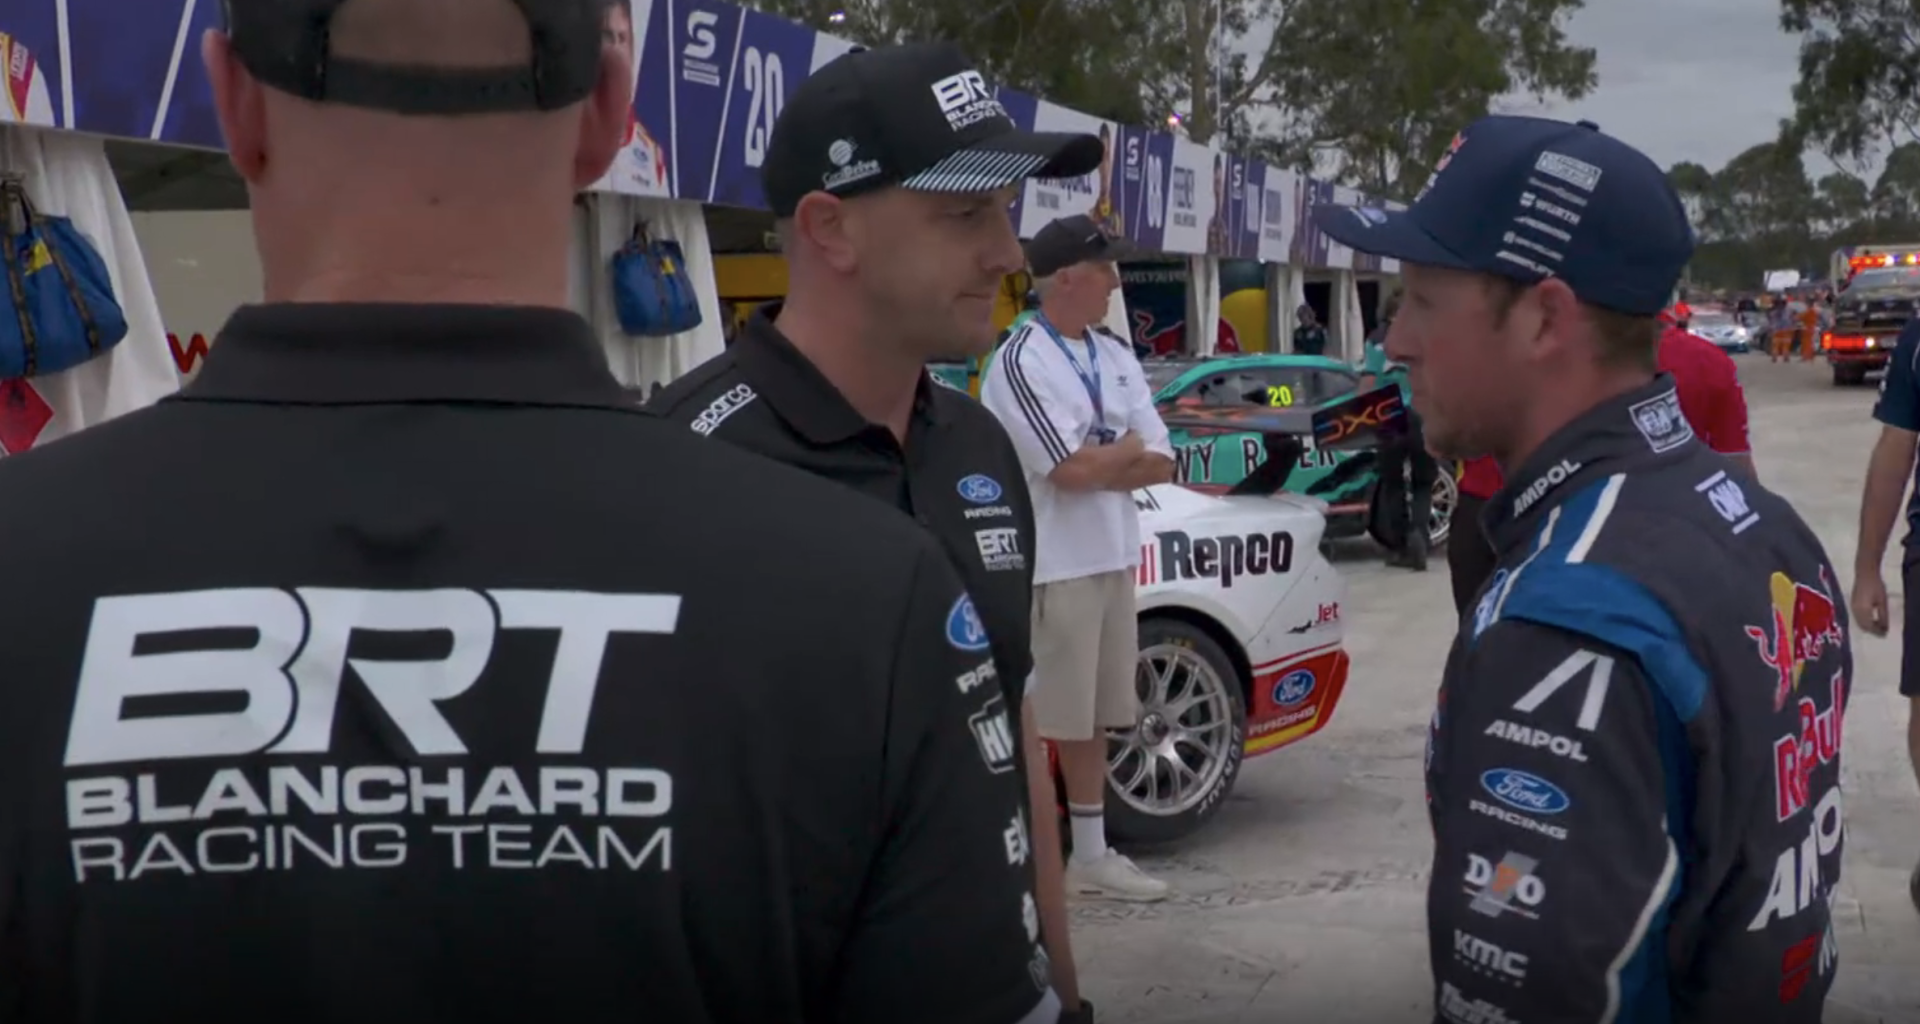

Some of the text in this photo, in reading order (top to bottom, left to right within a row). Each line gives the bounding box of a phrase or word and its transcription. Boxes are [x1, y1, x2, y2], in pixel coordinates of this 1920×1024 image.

[744, 45, 784, 169] 20
[1147, 154, 1163, 229] 88
[690, 383, 757, 437] sparco
[1267, 385, 1293, 407] 20
[1513, 459, 1582, 518] AMPOL
[974, 527, 1019, 553] BRT
[63, 587, 682, 766] BRT
[1279, 672, 1308, 698] Ford
[1484, 719, 1588, 762] AMPOL
[66, 766, 674, 829] BLANCHARD
[1496, 773, 1553, 809] Ford
[1469, 799, 1568, 841] RACING
[70, 822, 672, 882] RACING TEAM
